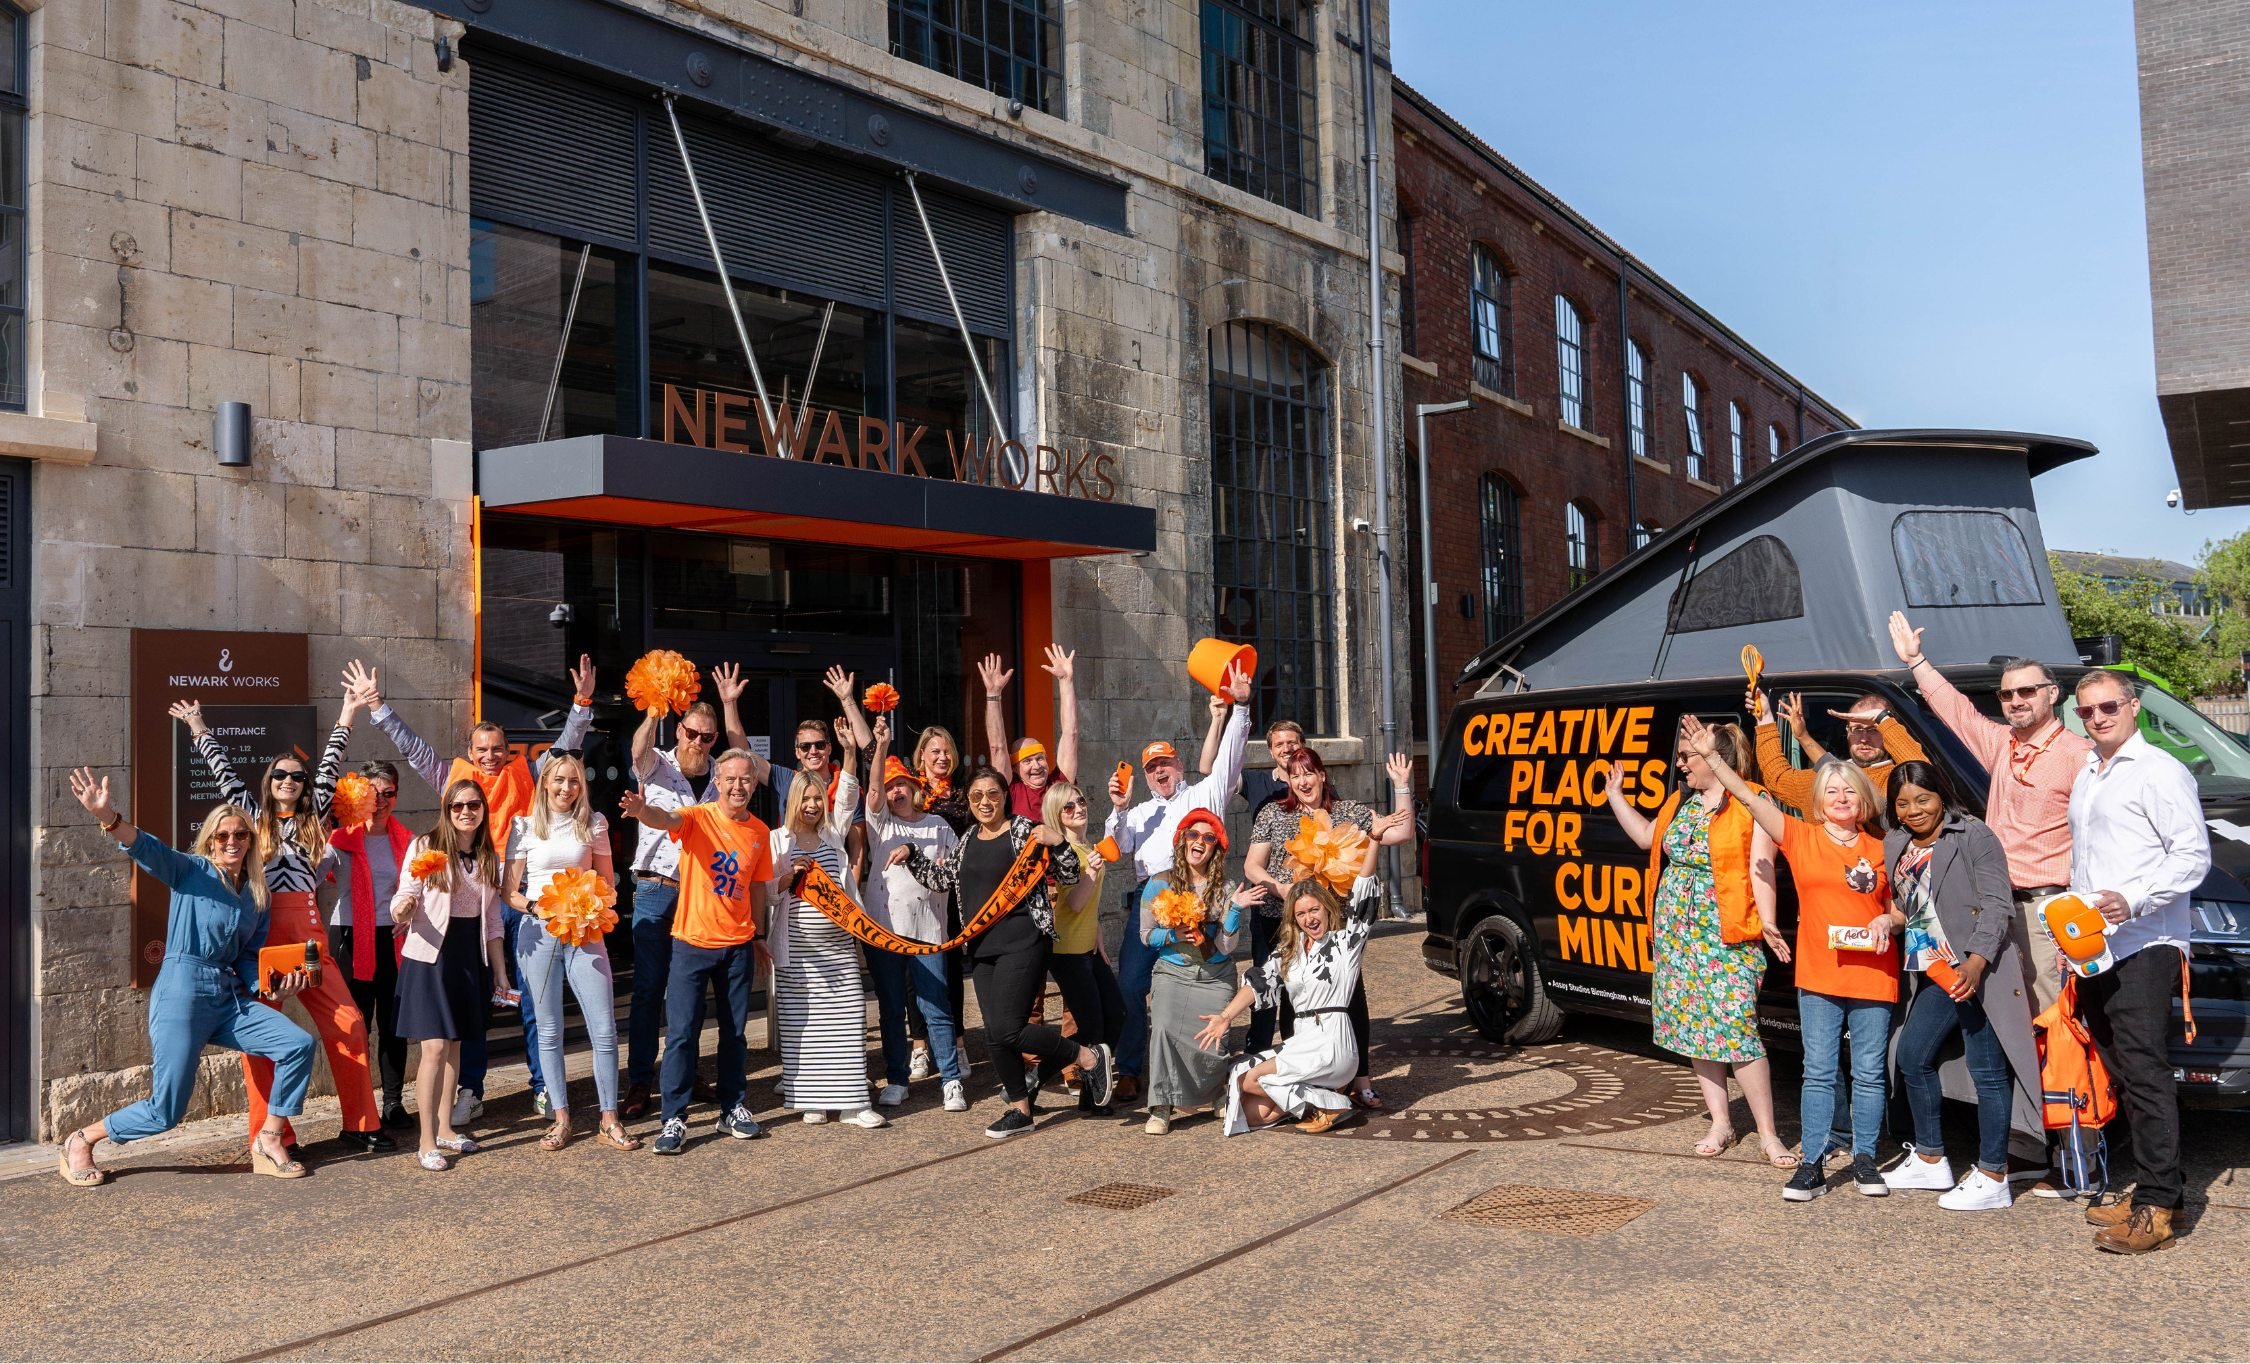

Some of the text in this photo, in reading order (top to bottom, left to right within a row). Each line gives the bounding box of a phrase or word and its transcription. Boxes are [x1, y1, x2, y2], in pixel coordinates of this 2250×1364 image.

[664, 383, 1115, 501] NEWARK WORKS
[169, 675, 280, 688] NEWARK WORKS
[216, 727, 266, 736] ENTRANCE
[1463, 706, 1655, 757] CREATIVE
[1509, 758, 1668, 809] PLACES
[1504, 810, 1582, 857] FOR
[713, 874, 737, 898] 21
[1552, 980, 1652, 1006] Assay Studios Birmingham Piano
[1760, 1018, 1800, 1031] Bridgwate
